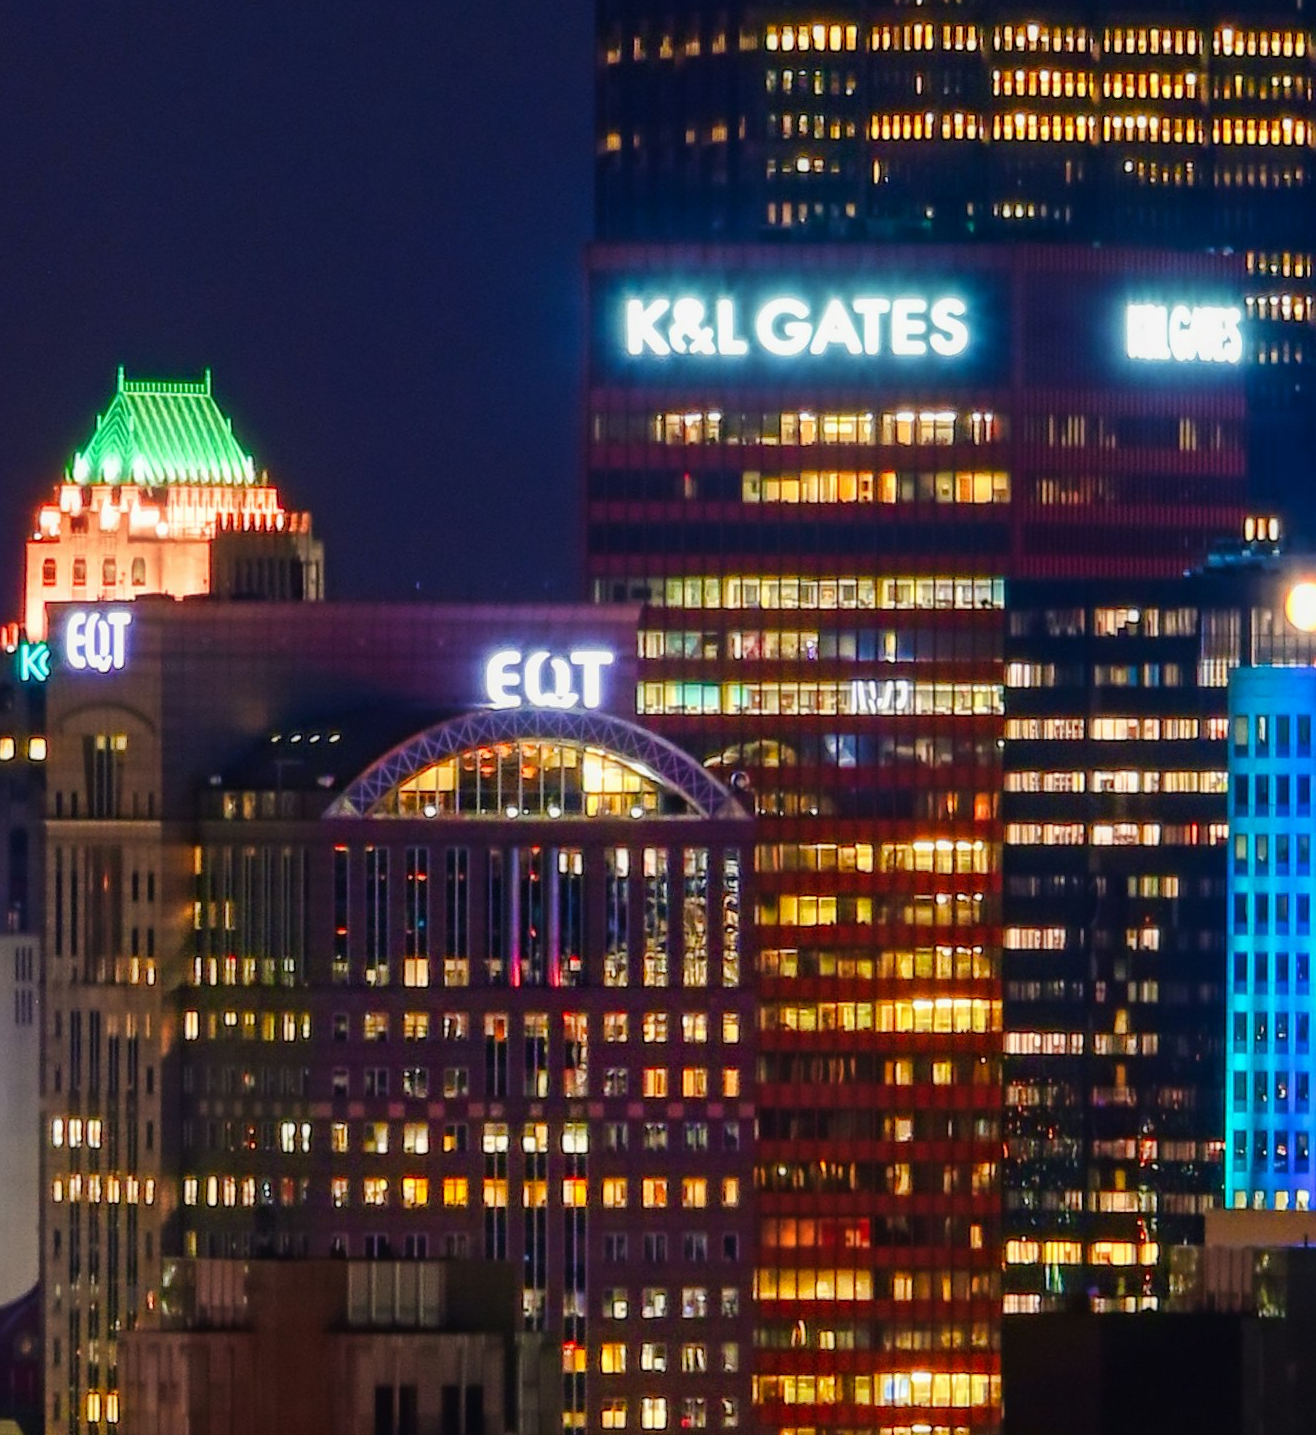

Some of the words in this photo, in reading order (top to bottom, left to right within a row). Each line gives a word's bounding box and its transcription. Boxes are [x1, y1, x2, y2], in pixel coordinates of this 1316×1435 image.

[627, 297, 748, 356] K&L
[756, 297, 969, 357] GATES
[66, 612, 132, 673] EQT
[486, 651, 614, 710] EQT
